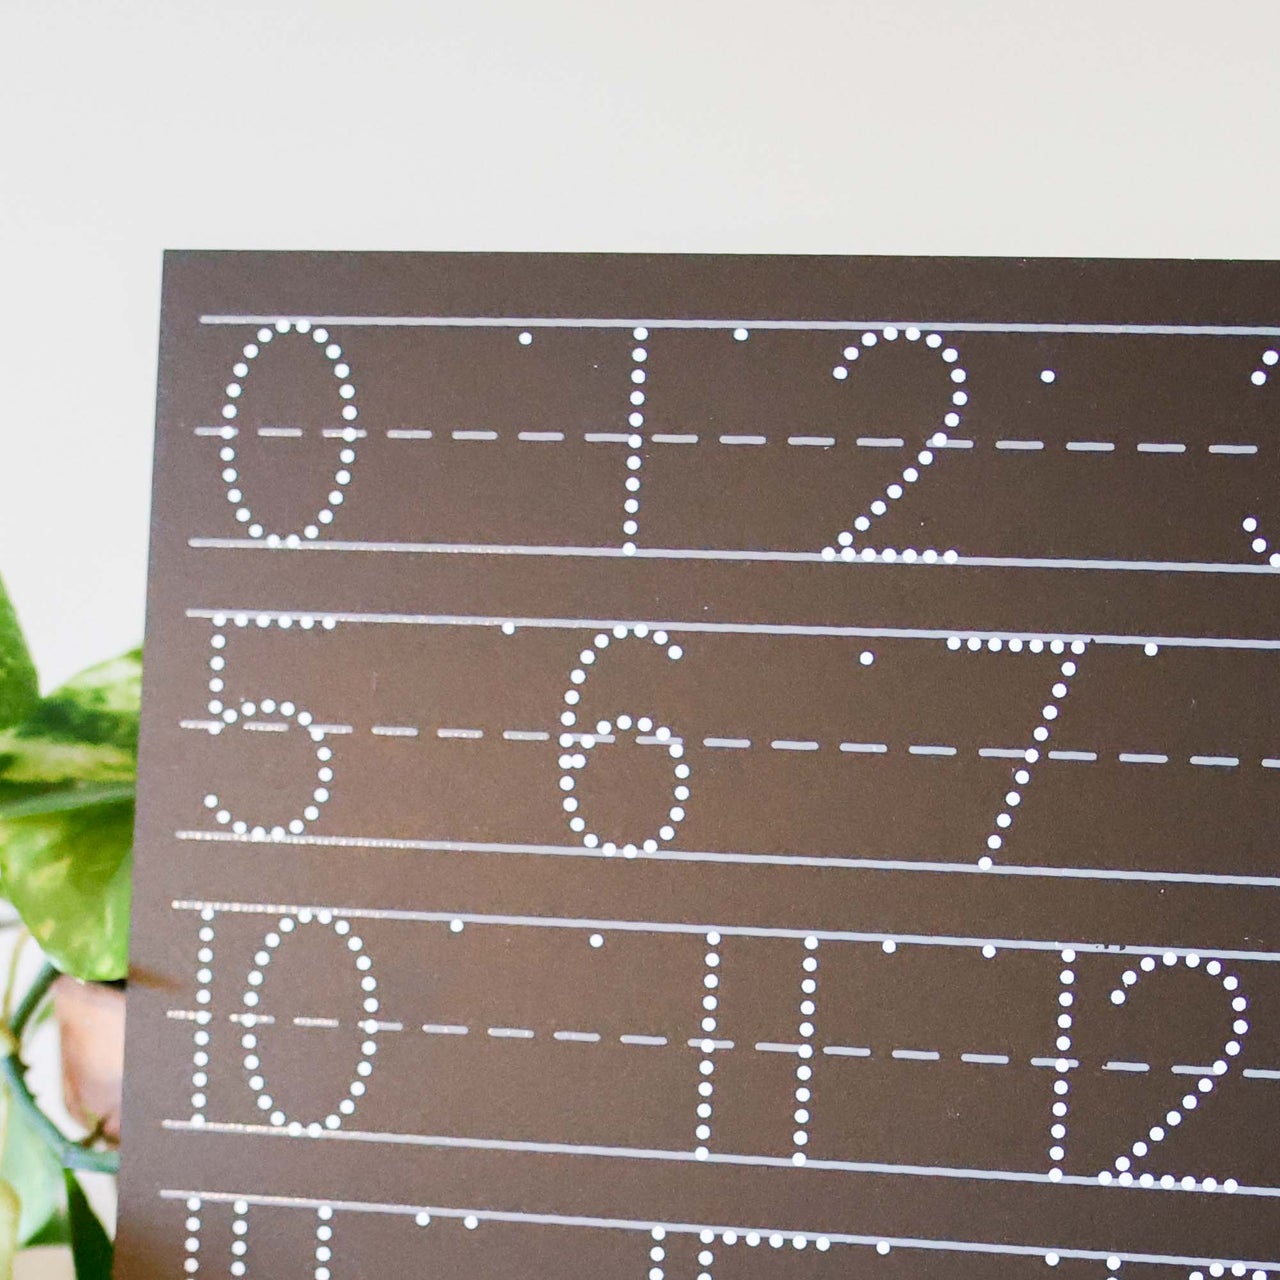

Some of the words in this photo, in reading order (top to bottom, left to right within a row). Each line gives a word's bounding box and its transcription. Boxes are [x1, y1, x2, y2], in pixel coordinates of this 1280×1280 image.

[220, 319, 356, 548] 0
[622, 327, 647, 555] 1
[821, 327, 967, 563] 2
[204, 613, 333, 840] 5
[559, 623, 689, 859] 6
[947, 637, 1085, 870] 7
[191, 908, 378, 1137] 10
[695, 932, 818, 1166] 11
[1048, 949, 1248, 1193] 12
